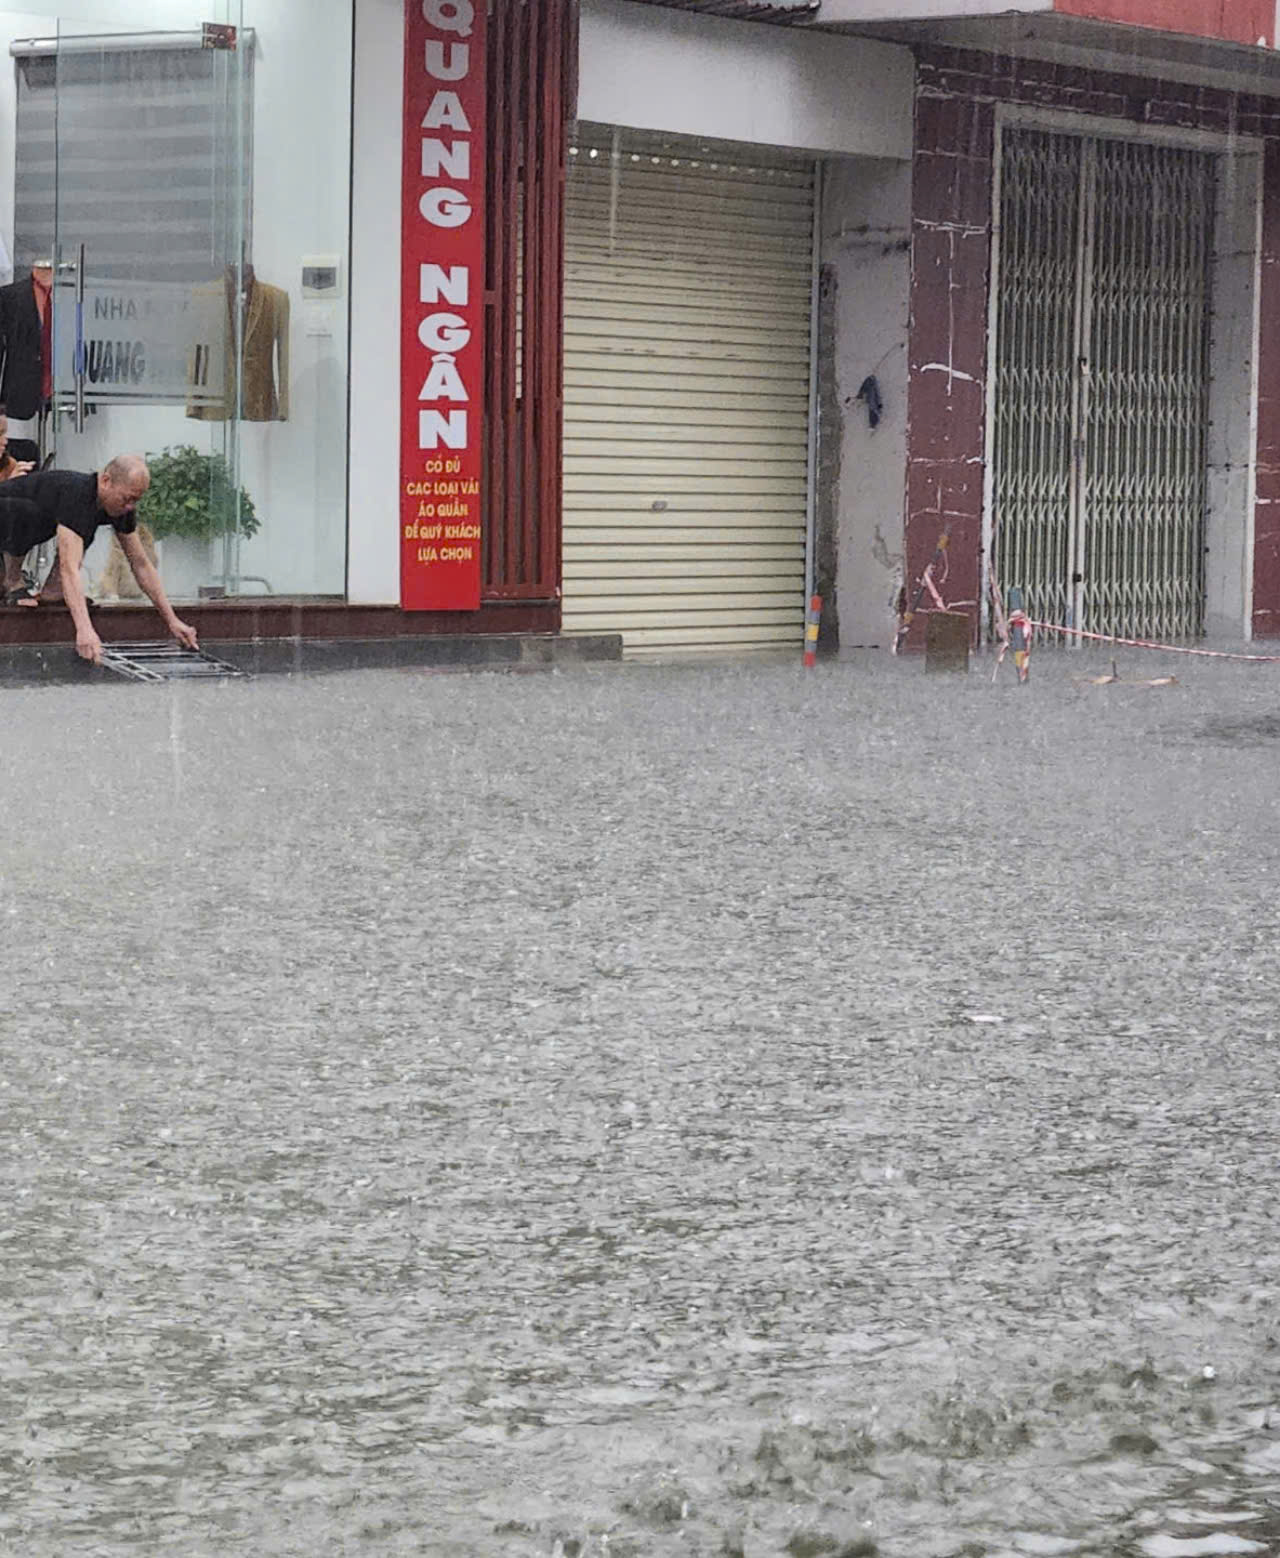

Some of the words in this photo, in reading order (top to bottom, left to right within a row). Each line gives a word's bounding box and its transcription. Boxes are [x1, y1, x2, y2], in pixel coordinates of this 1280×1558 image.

[419, 0, 474, 228] QUANG
[418, 263, 471, 449] NGÂN
[425, 454, 443, 473] CÓ
[445, 455, 461, 473] ĐỦ
[434, 482, 459, 499] LOẠI
[418, 500, 435, 517] ÁO
[445, 522, 481, 539] KHÁCH
[440, 547, 473, 565] CHỌN
